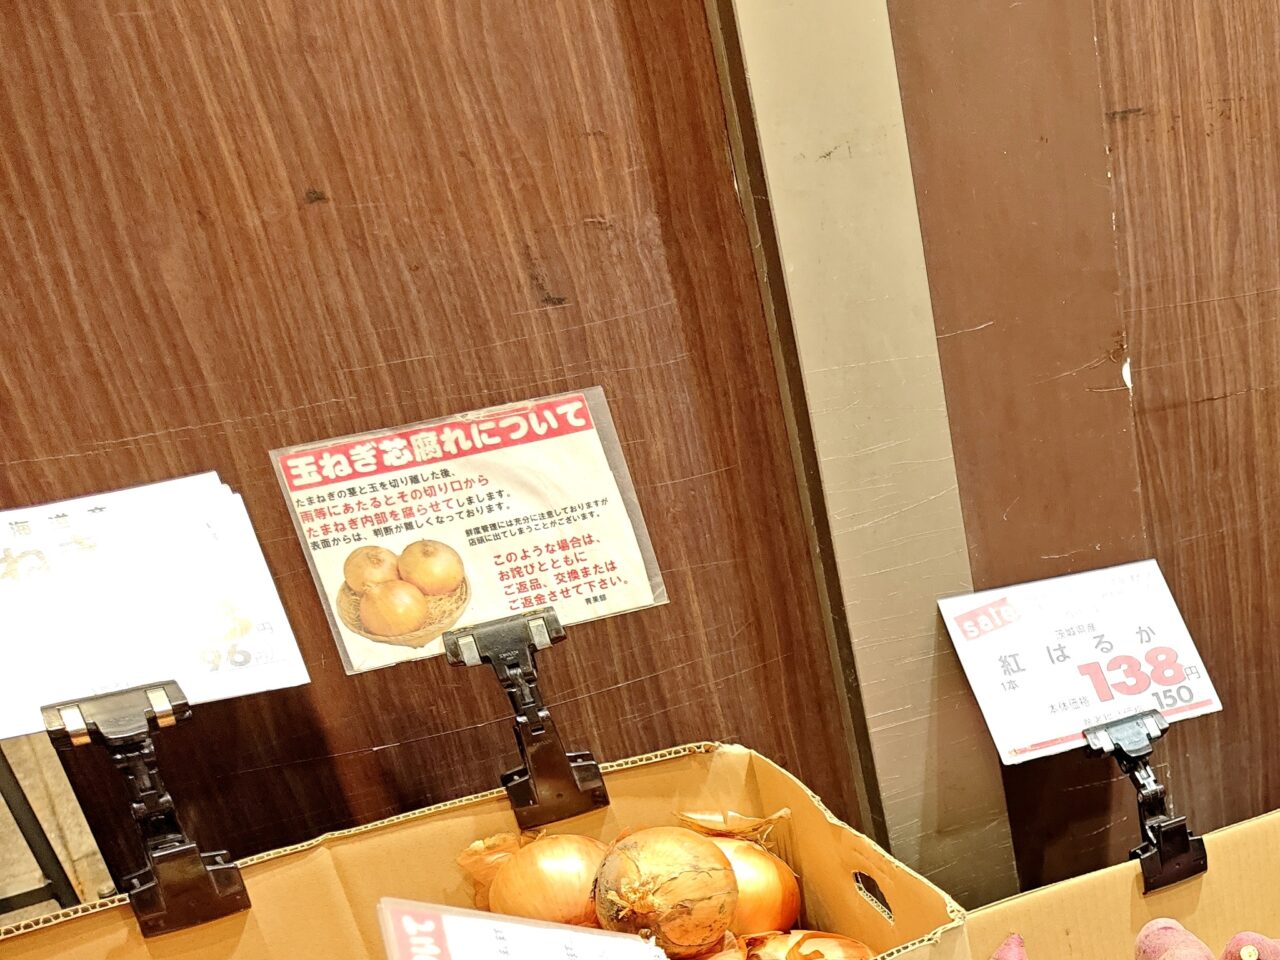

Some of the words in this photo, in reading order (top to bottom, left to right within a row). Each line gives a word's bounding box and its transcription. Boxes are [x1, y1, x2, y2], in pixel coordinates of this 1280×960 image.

[286, 398, 588, 487] 玉ねぎ芯腐れについて
[998, 625, 1156, 677] 紅はるか
[1152, 685, 1195, 710] 150
